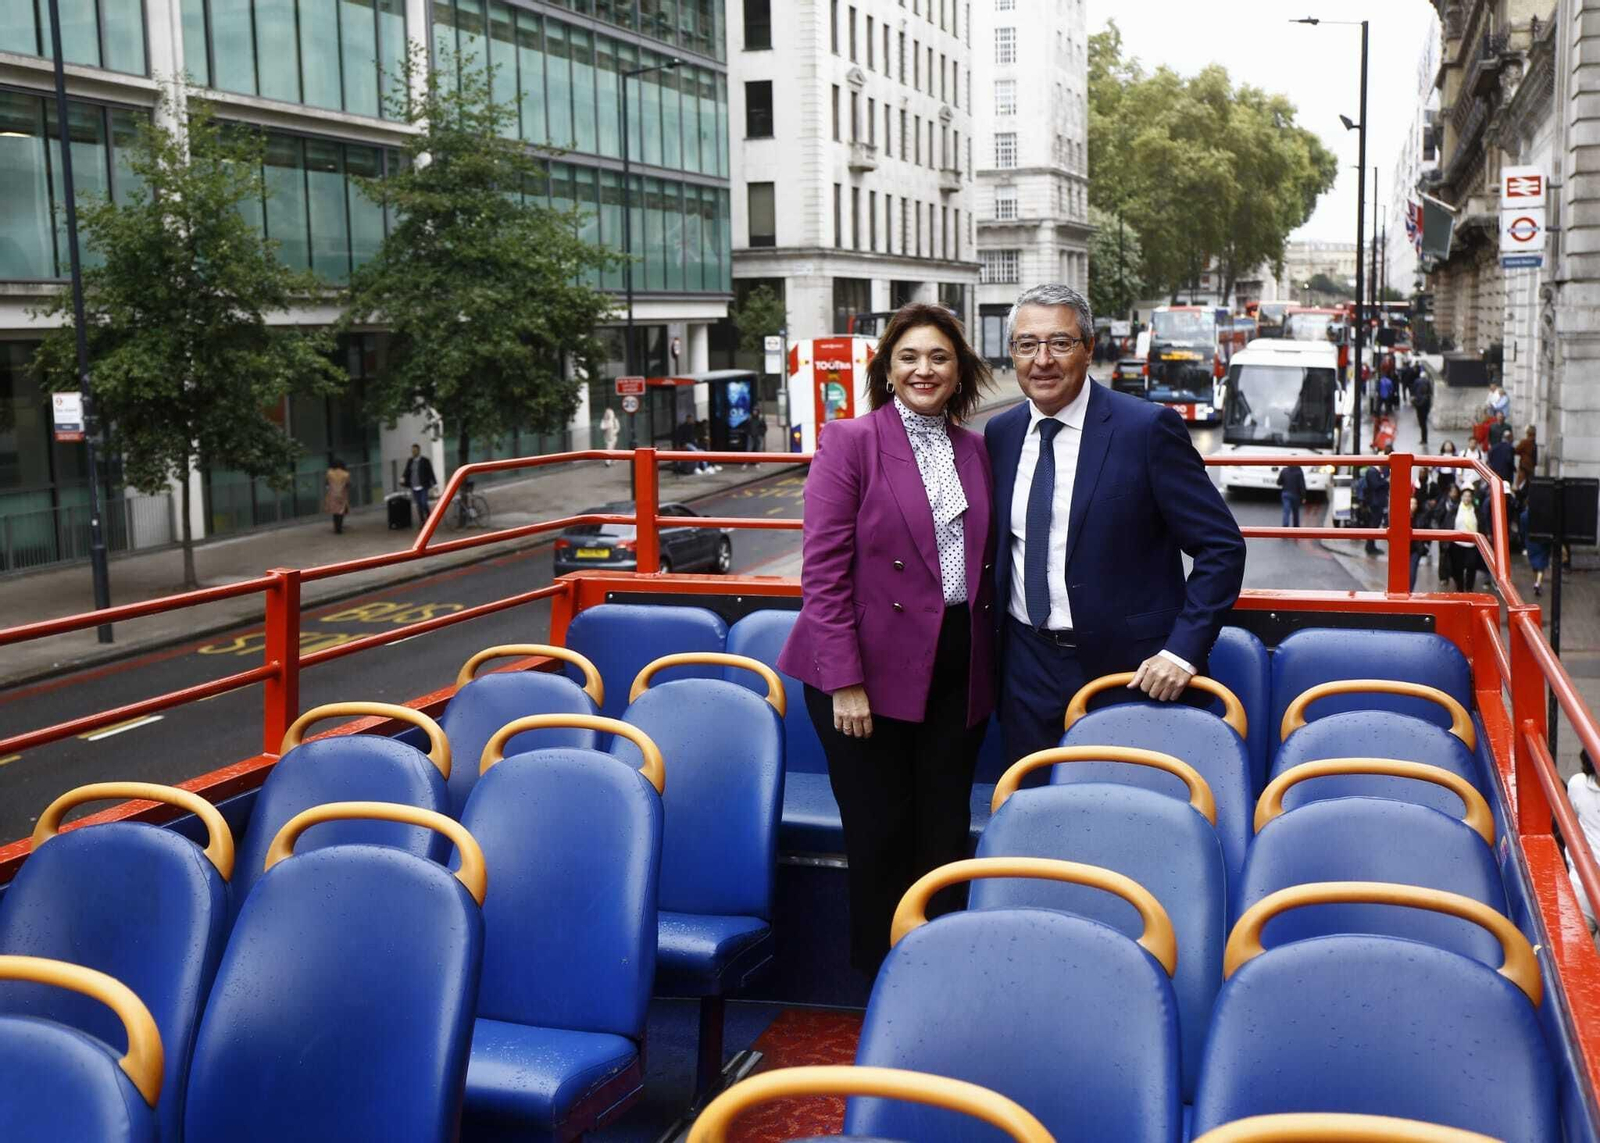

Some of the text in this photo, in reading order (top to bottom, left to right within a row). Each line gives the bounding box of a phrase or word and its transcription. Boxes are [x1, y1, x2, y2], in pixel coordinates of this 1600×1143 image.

[624, 400, 637, 409] 20
[319, 602, 465, 624] BUS
[197, 632, 375, 656] SO
